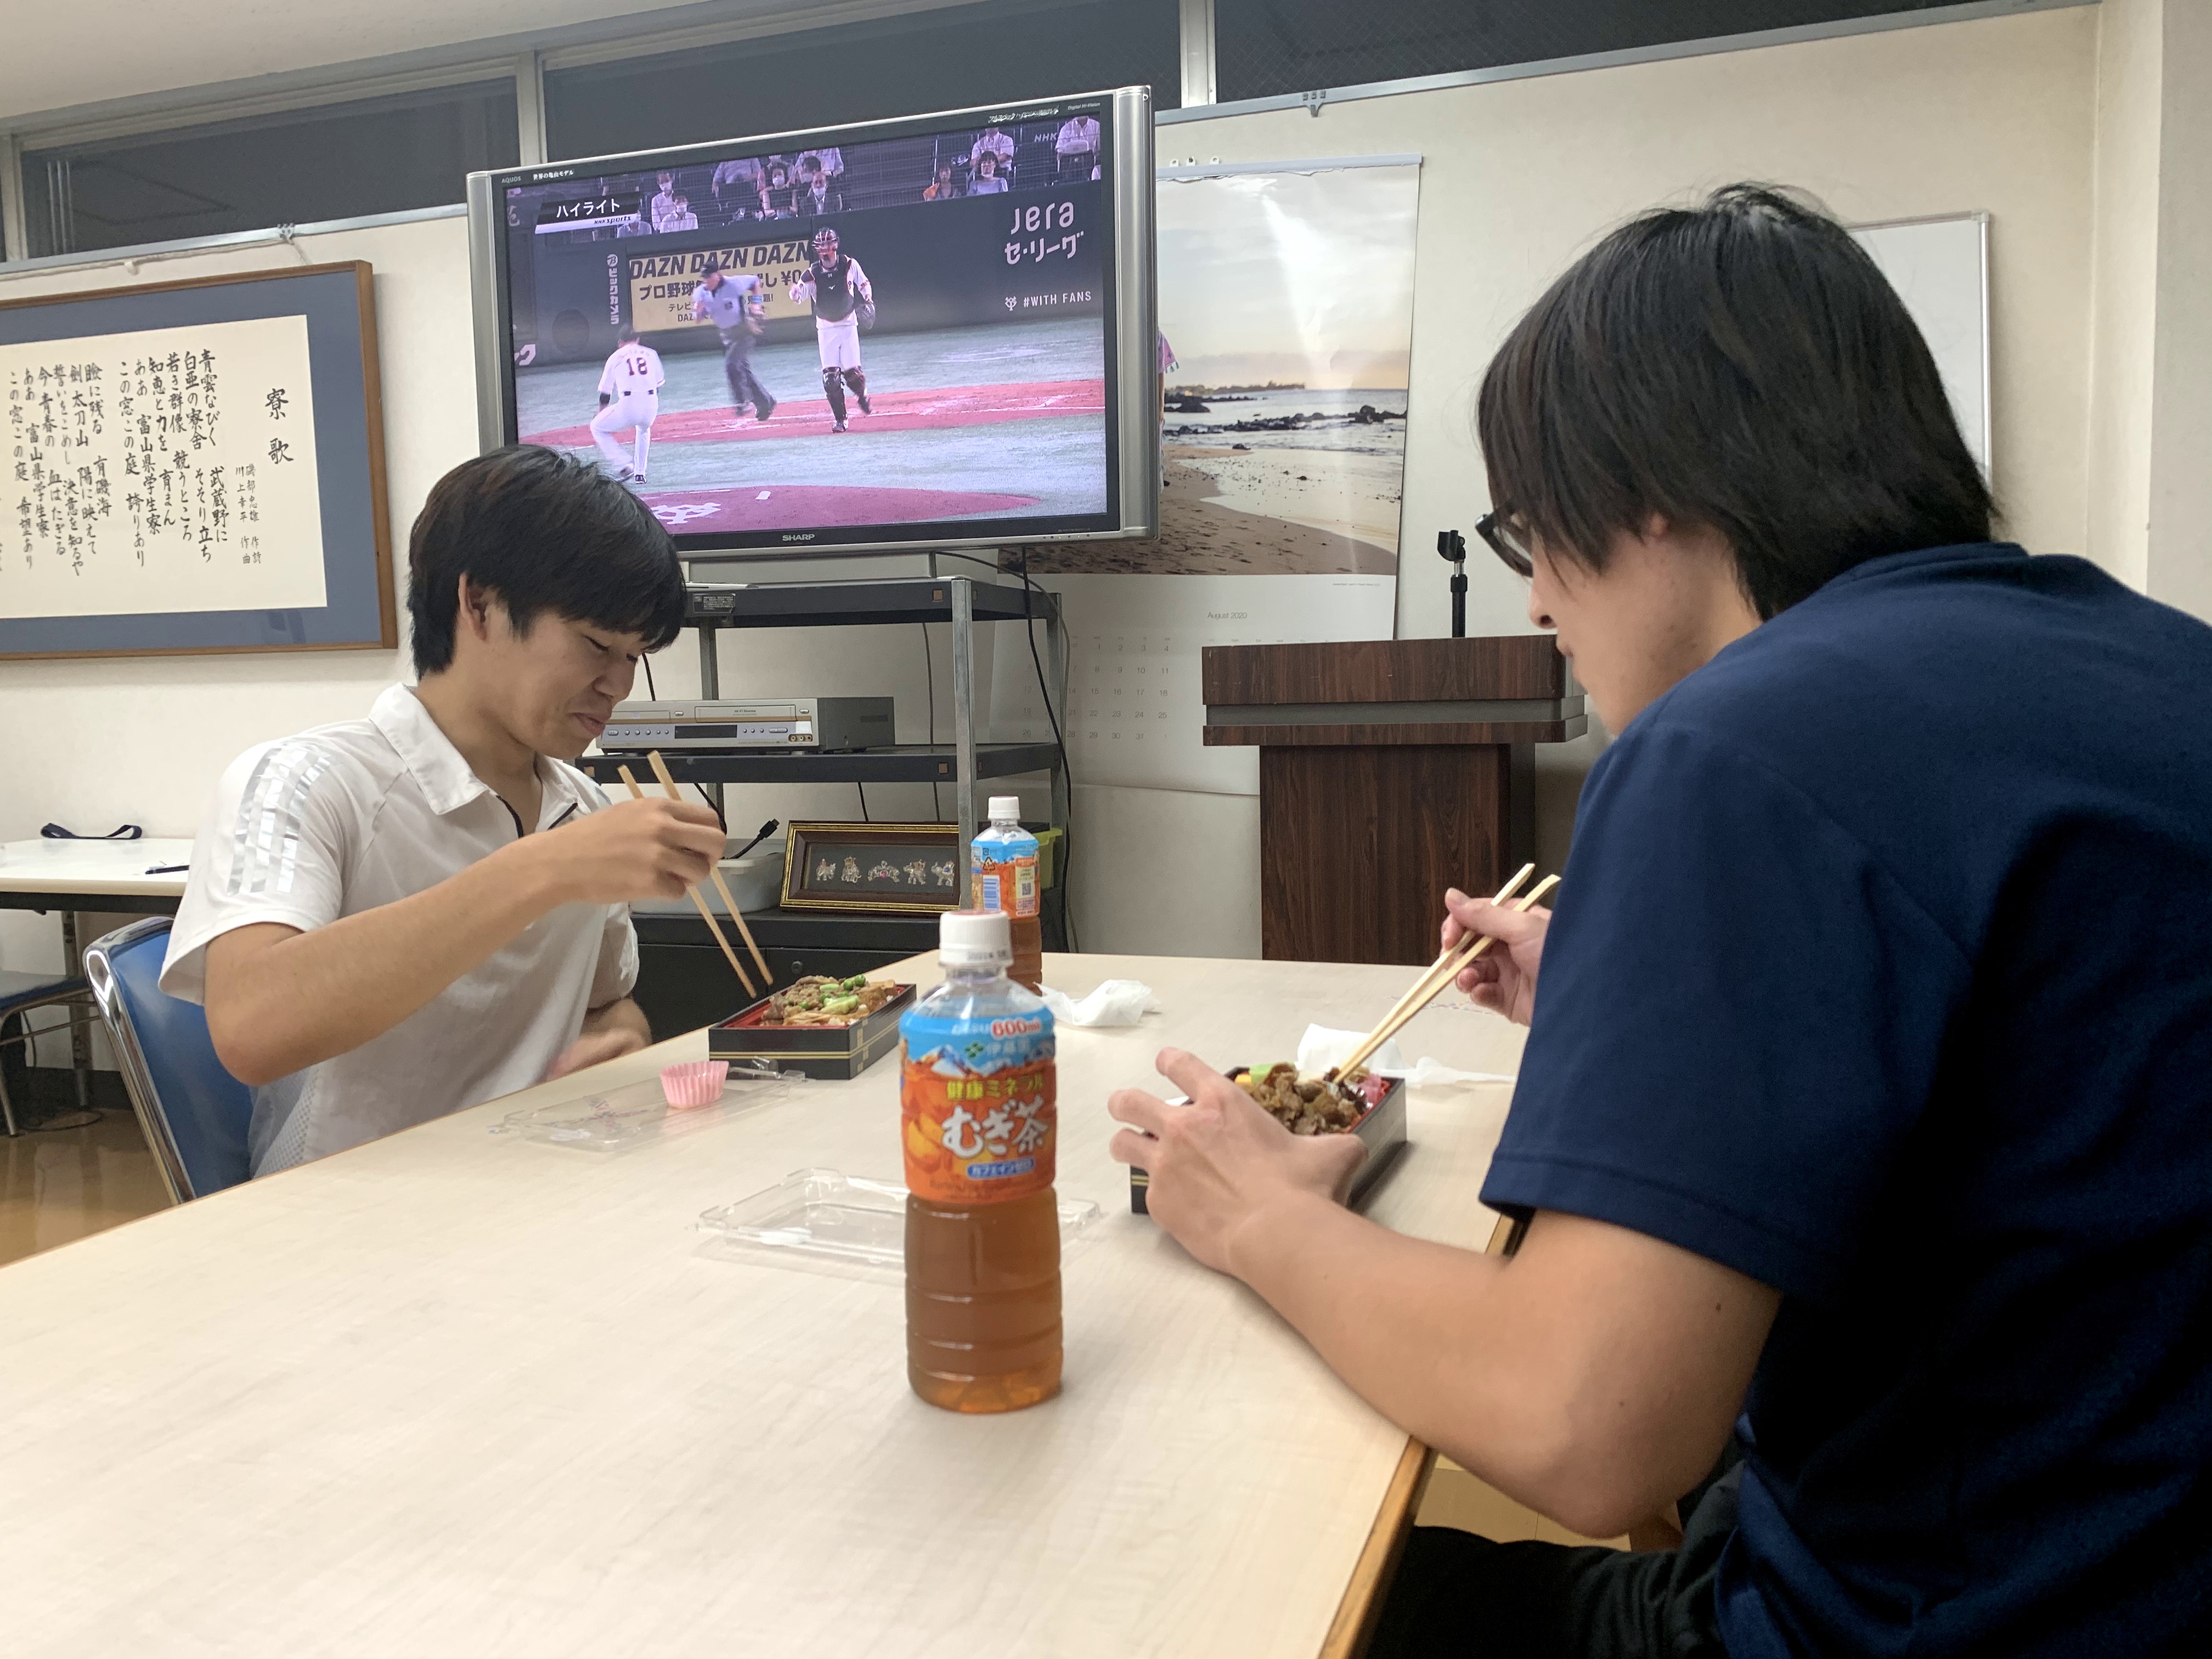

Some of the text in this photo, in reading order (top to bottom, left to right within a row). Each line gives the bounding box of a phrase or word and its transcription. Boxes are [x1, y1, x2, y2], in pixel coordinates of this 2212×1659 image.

[1034, 132, 1057, 142] NHK
[556, 198, 620, 218] ハイライト
[630, 242, 810, 280] DAZN DAZN DAZN
[1023, 291, 1092, 307] #WITH FANS
[668, 300, 693, 312] テレビ
[626, 357, 648, 376] 18
[9, 371, 33, 569] この窓この庭 希望あり
[24, 367, 50, 538] ああ 富山県学生寮
[119, 361, 144, 567] この窓この庭 誇りあり
[134, 358, 161, 535] ああ 富山県学生寮
[148, 357, 176, 526] 知恵と力を 育まん
[166, 352, 192, 541] 若き群像 競うところ
[199, 348, 229, 543] 青雲なびく 武蔵野に
[264, 388, 294, 465] 寮歌
[47, 469, 66, 556] 血はたぎる
[63, 478, 83, 576] 決意を知るや
[77, 466, 98, 554] 陽に映えて
[195, 467, 213, 563] そそり立ち
[236, 466, 250, 565] 川上幸平 作曲
[250, 535, 262, 565] 作詩
[782, 533, 815, 541] SHARP
[1207, 612, 1229, 620] August
[941, 1093, 1048, 1159] むぎ茶
